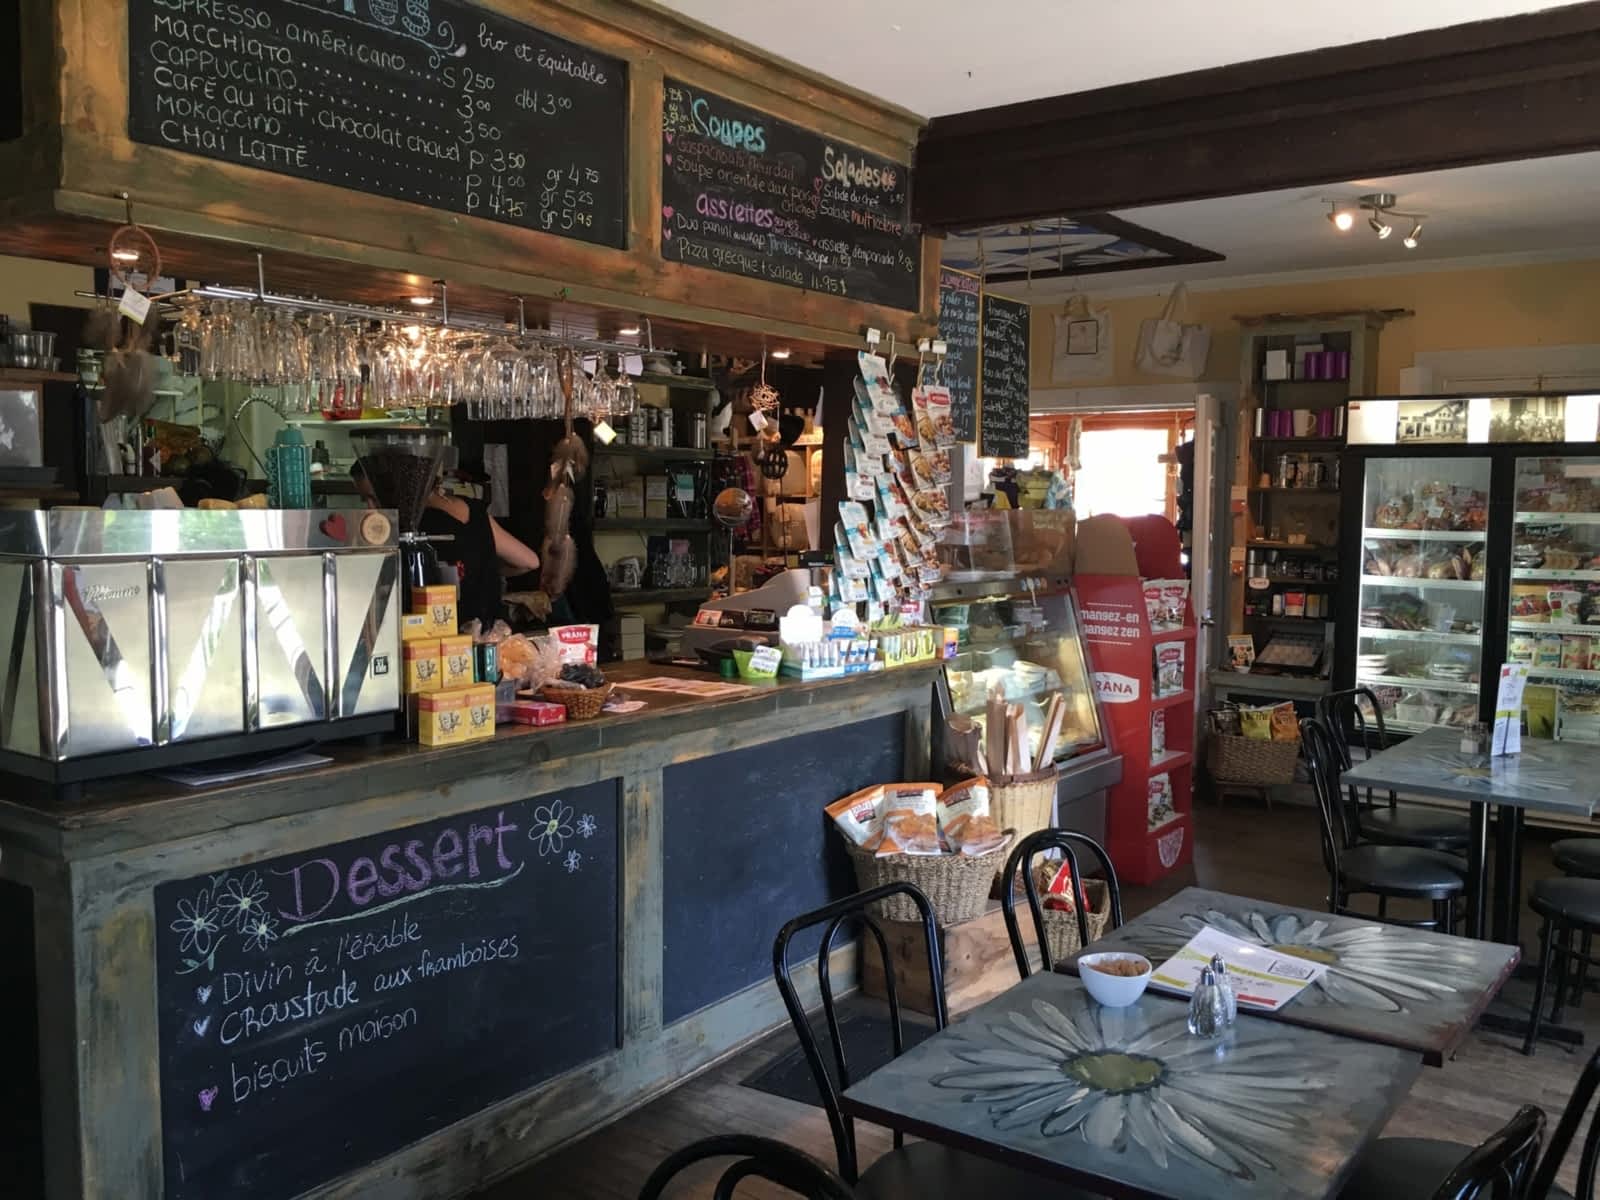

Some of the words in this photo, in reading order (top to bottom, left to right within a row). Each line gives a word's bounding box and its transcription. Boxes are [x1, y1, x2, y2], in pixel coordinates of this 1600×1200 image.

[478, 22, 508, 50] bio
[514, 44, 533, 63] et
[537, 48, 607, 85] équitable
[223, 85, 254, 107] au
[407, 135, 460, 162] chaud
[542, 168, 563, 192] gr
[693, 98, 766, 153] Soupes
[677, 155, 713, 181] Soupe
[768, 182, 788, 197] aux
[821, 146, 881, 188] Salades
[703, 221, 732, 240] panini
[677, 236, 708, 259] Pizza
[712, 247, 759, 272] grecque
[768, 263, 804, 284] salade
[1121, 627, 1140, 638] zen
[1095, 680, 1133, 694] RANA
[270, 811, 519, 923] Dessert
[221, 963, 294, 1005] Divin
[373, 967, 412, 992] aux
[231, 1036, 327, 1104] biscuits
[338, 1004, 418, 1054] maison
